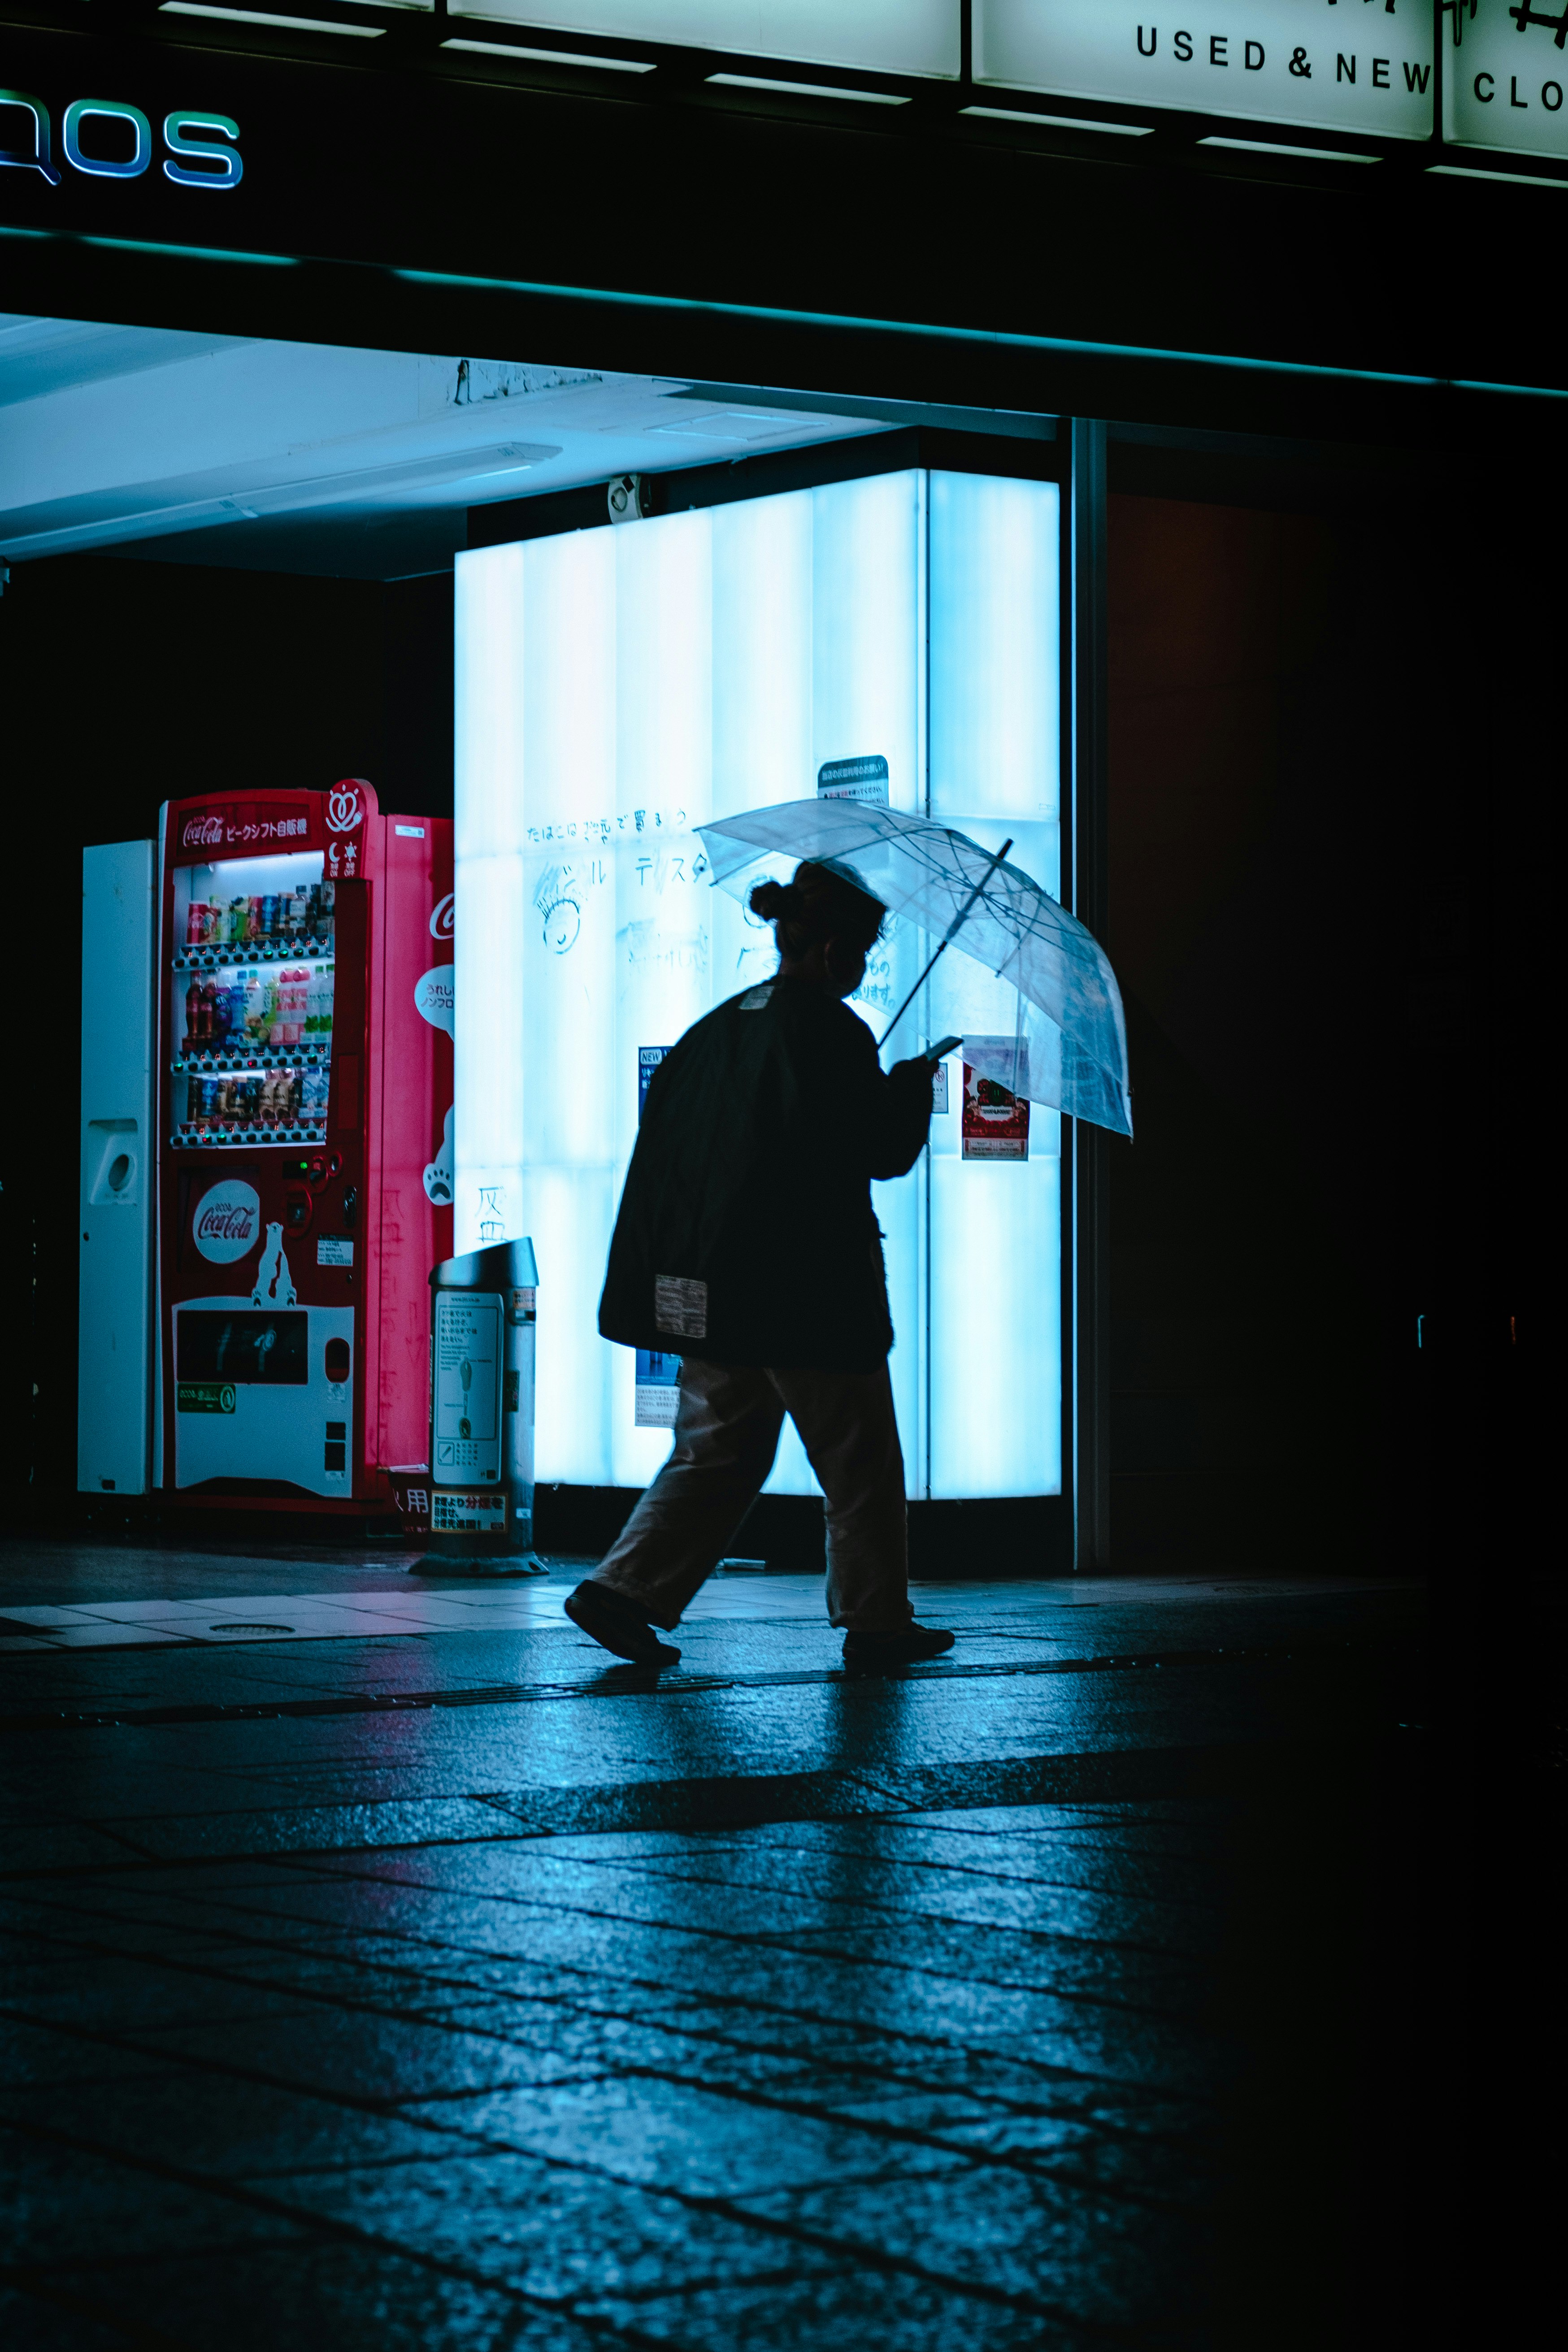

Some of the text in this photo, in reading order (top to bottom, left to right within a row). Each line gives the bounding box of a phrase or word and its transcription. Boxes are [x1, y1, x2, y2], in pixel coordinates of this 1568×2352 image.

[1137, 26, 1564, 112] USED & NEW CLO
[642, 1051, 660, 1063] NEW
